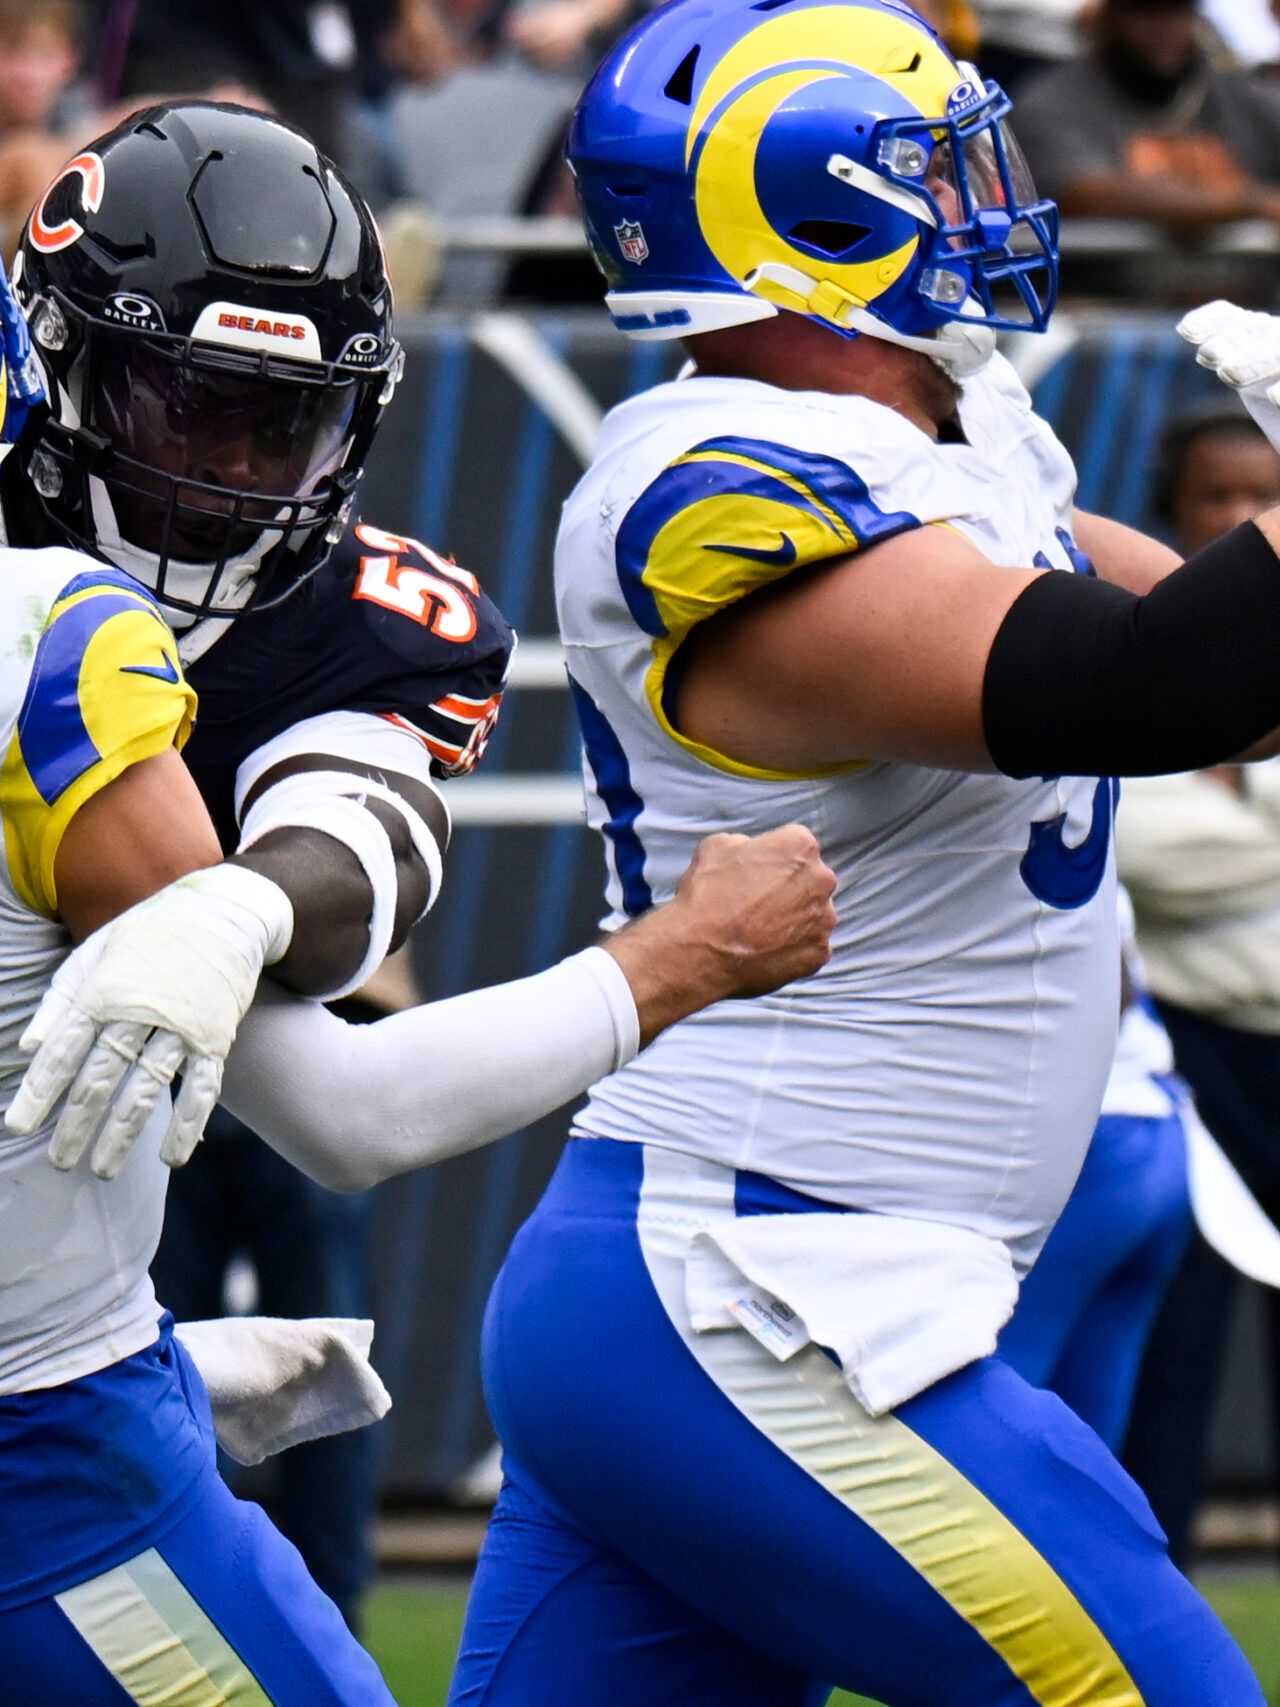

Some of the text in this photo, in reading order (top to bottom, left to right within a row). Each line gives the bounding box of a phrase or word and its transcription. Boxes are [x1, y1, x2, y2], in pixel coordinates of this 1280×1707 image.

[28, 152, 105, 253] C
[104, 308, 158, 331] OAKLEY
[218, 313, 305, 340] BEARS
[345, 354, 377, 363] OAKLEY
